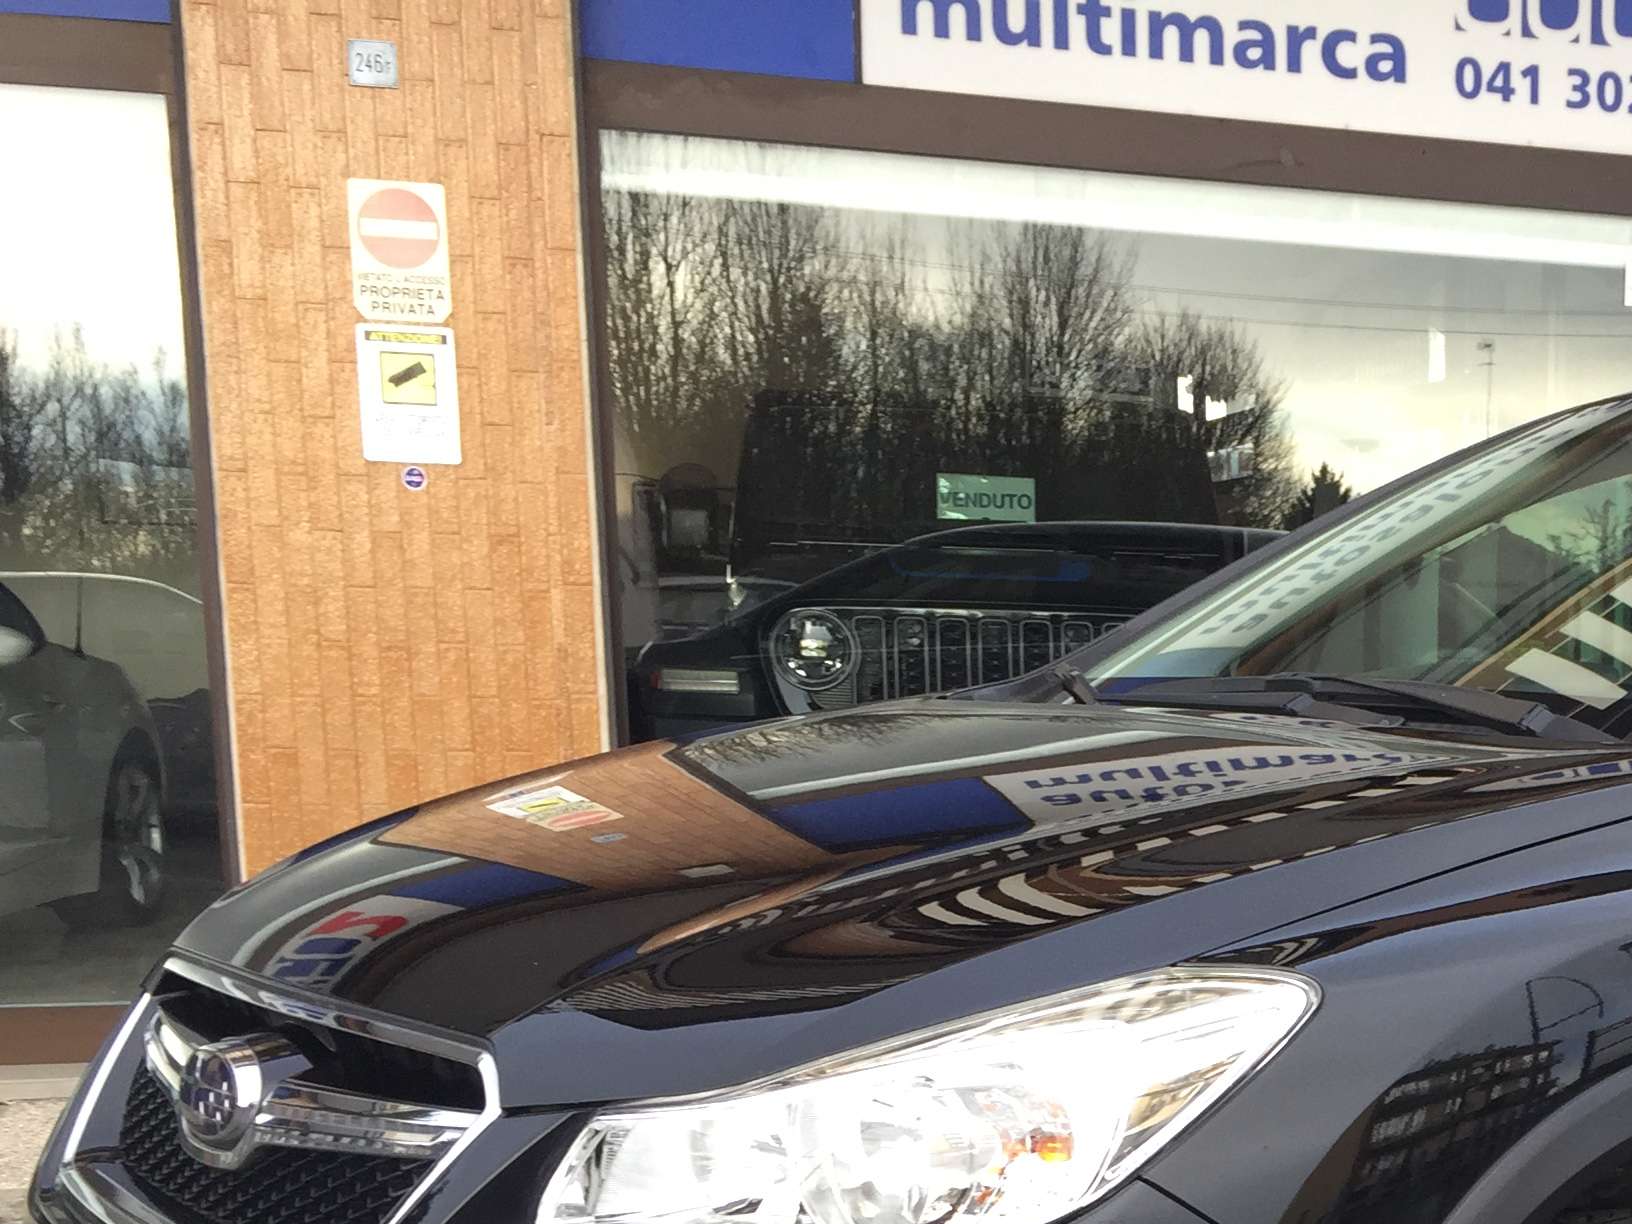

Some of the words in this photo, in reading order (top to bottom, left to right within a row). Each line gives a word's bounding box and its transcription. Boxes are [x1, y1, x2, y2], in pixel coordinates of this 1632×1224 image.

[1455, 57, 1541, 105] 041
[371, 301, 434, 314] PRIVATA
[939, 492, 1033, 510] VENDUTO
